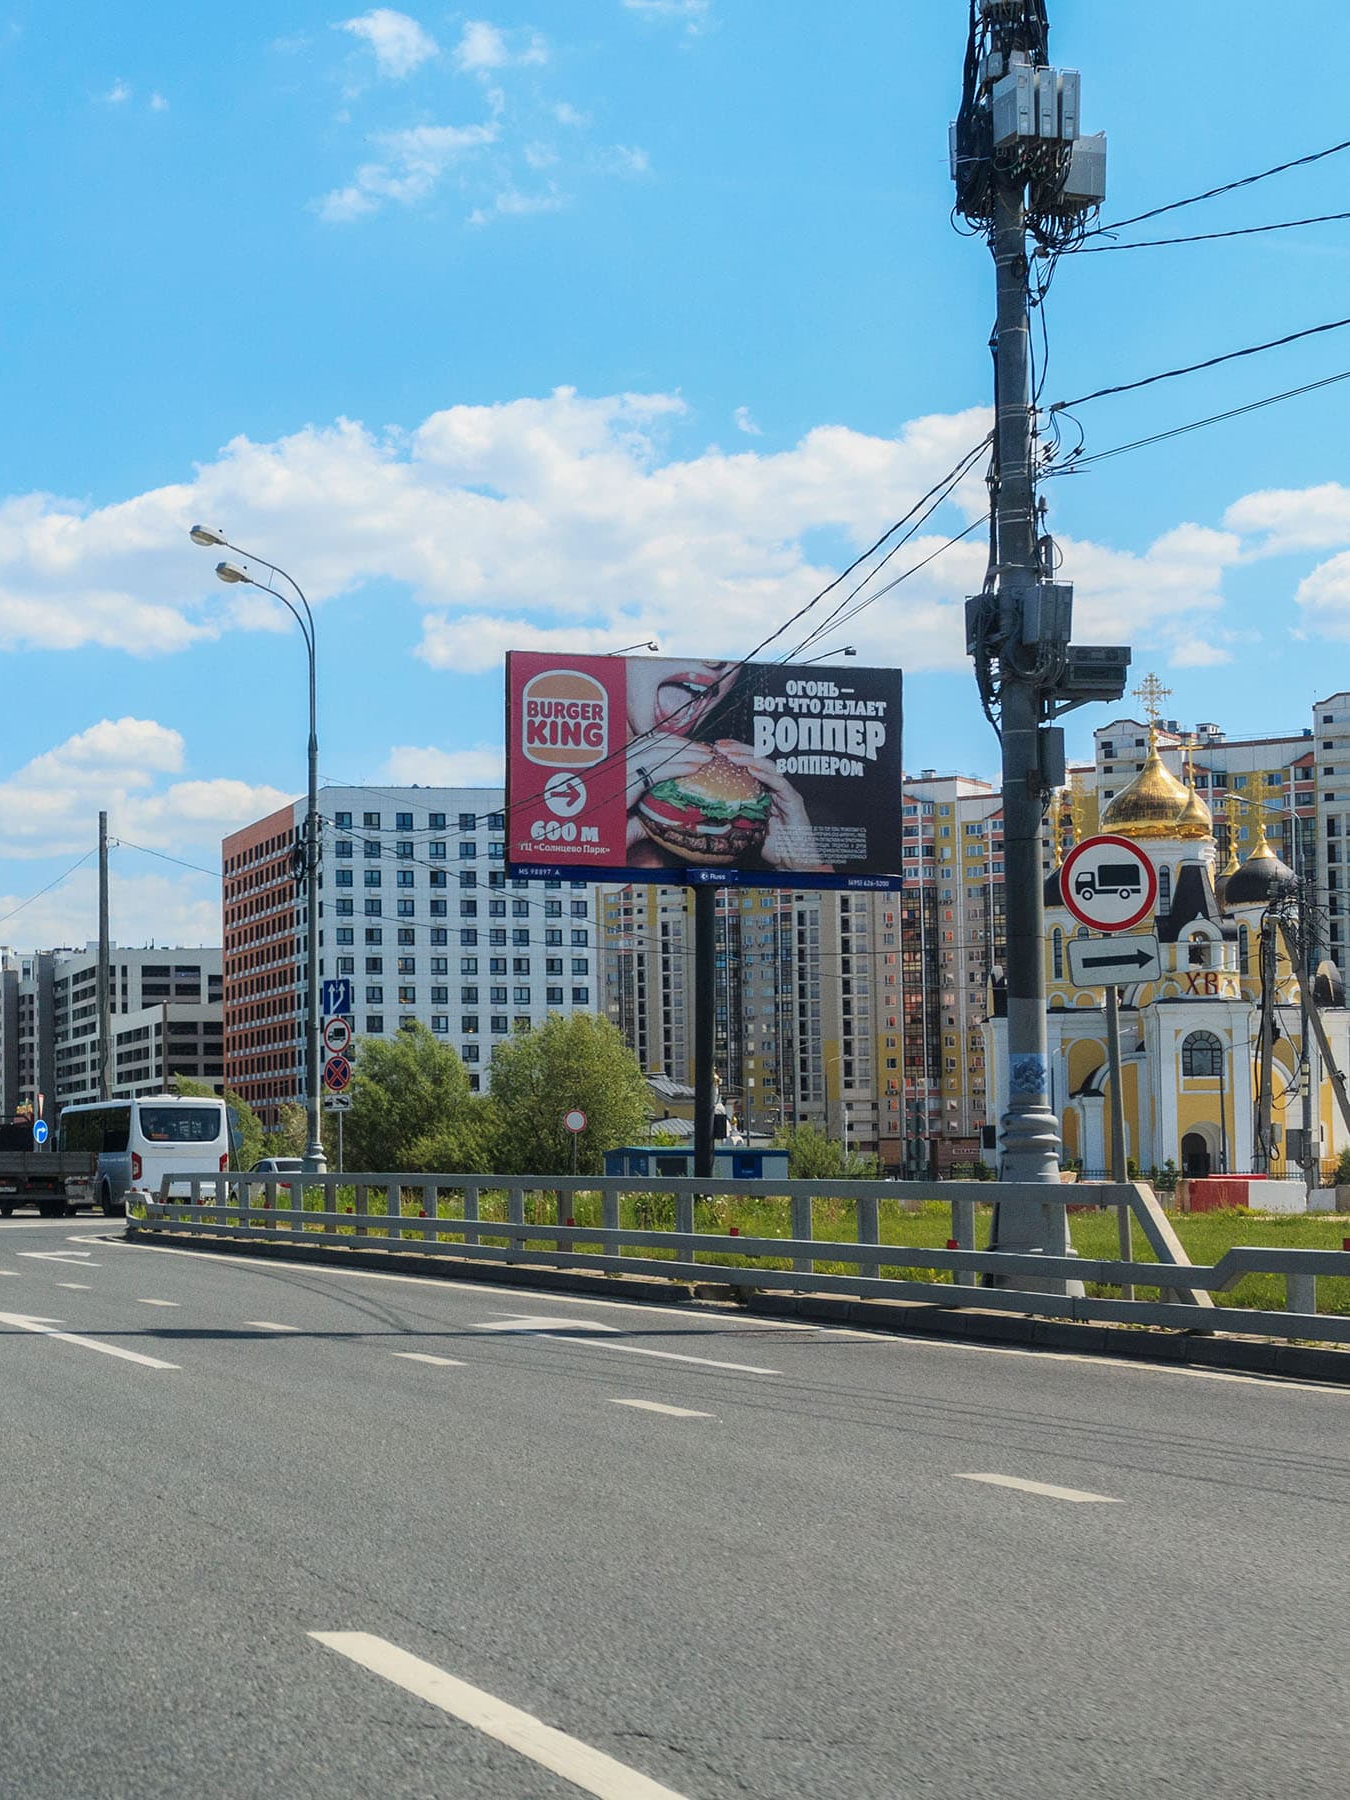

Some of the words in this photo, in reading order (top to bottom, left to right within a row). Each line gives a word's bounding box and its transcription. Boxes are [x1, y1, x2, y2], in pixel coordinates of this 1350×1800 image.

[786, 680, 839, 697] ОГОНЬ
[527, 700, 603, 721] BURGER
[753, 696, 786, 712] ВОТ
[788, 698, 821, 714] ЧТО
[822, 699, 887, 716] ДЕЛАЕТ
[527, 719, 603, 747] KING
[753, 715, 886, 760] ВОППЕР
[776, 755, 864, 776] ВОППЕРОМ
[531, 820, 577, 841] 600
